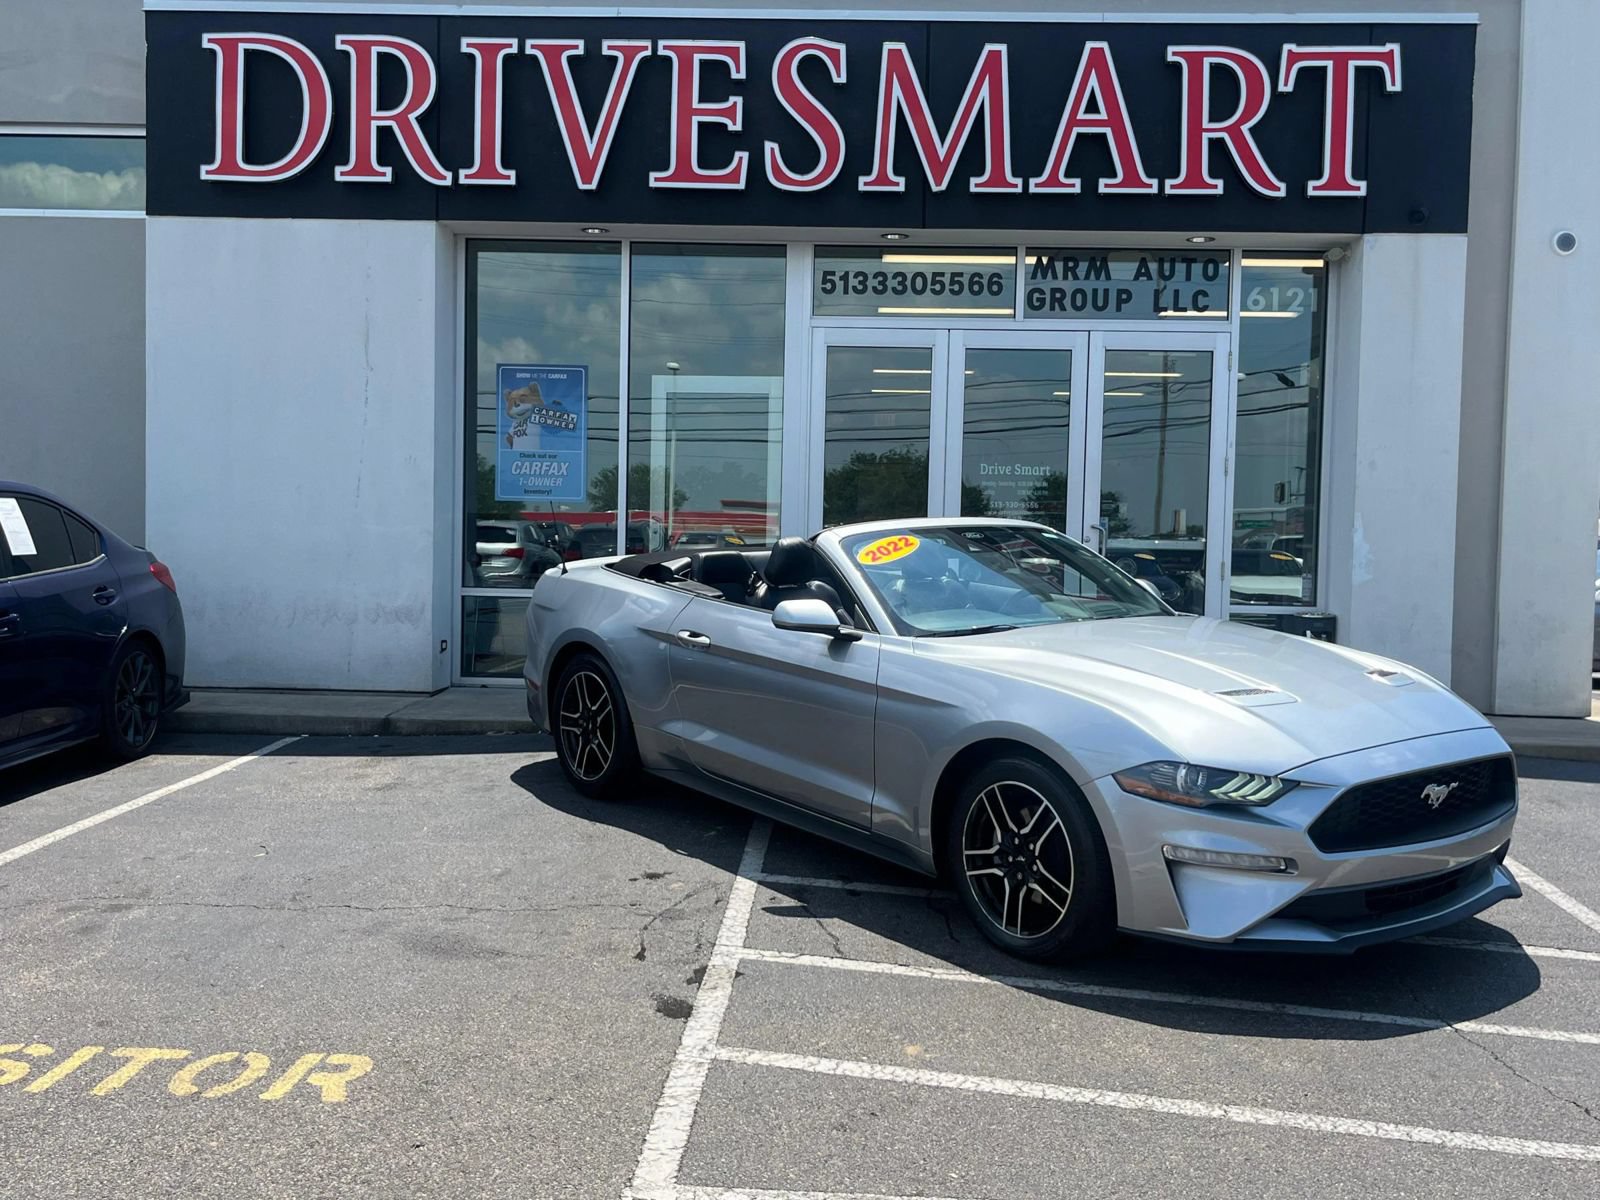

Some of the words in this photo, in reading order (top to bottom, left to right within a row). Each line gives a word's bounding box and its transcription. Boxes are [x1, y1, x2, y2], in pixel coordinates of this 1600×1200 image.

[200, 32, 1402, 198] DRIVESMART
[1030, 256, 1112, 281] MRM
[1132, 257, 1220, 282] AUTO
[821, 271, 1003, 296] 5133305566
[1026, 287, 1133, 313] GROUP
[1152, 289, 1211, 313] LLC
[1246, 286, 1319, 313] 6121
[534, 407, 577, 422] CARFAX
[513, 429, 528, 438] FOX
[511, 461, 569, 476] CARFAX
[980, 463, 1012, 475] Drive
[1014, 464, 1051, 476] Smart
[519, 477, 563, 487] 1-OWNER
[865, 536, 915, 563] 2022
